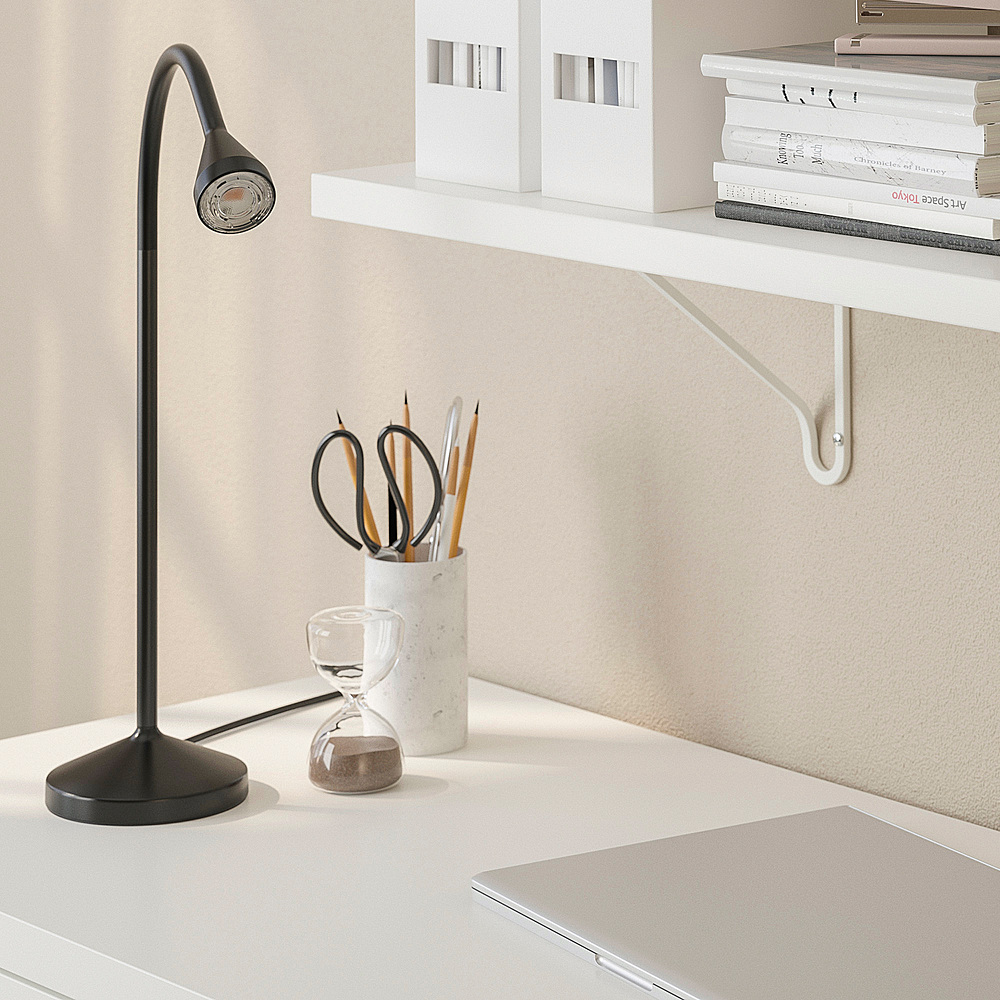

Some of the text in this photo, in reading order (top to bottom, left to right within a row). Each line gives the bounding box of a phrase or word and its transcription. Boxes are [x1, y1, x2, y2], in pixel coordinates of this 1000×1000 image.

[777, 132, 792, 165] Knowing
[811, 144, 825, 166] Much
[853, 155, 947, 176] Chronicles of Barney
[891, 189, 967, 210] Art Space Tokyo
